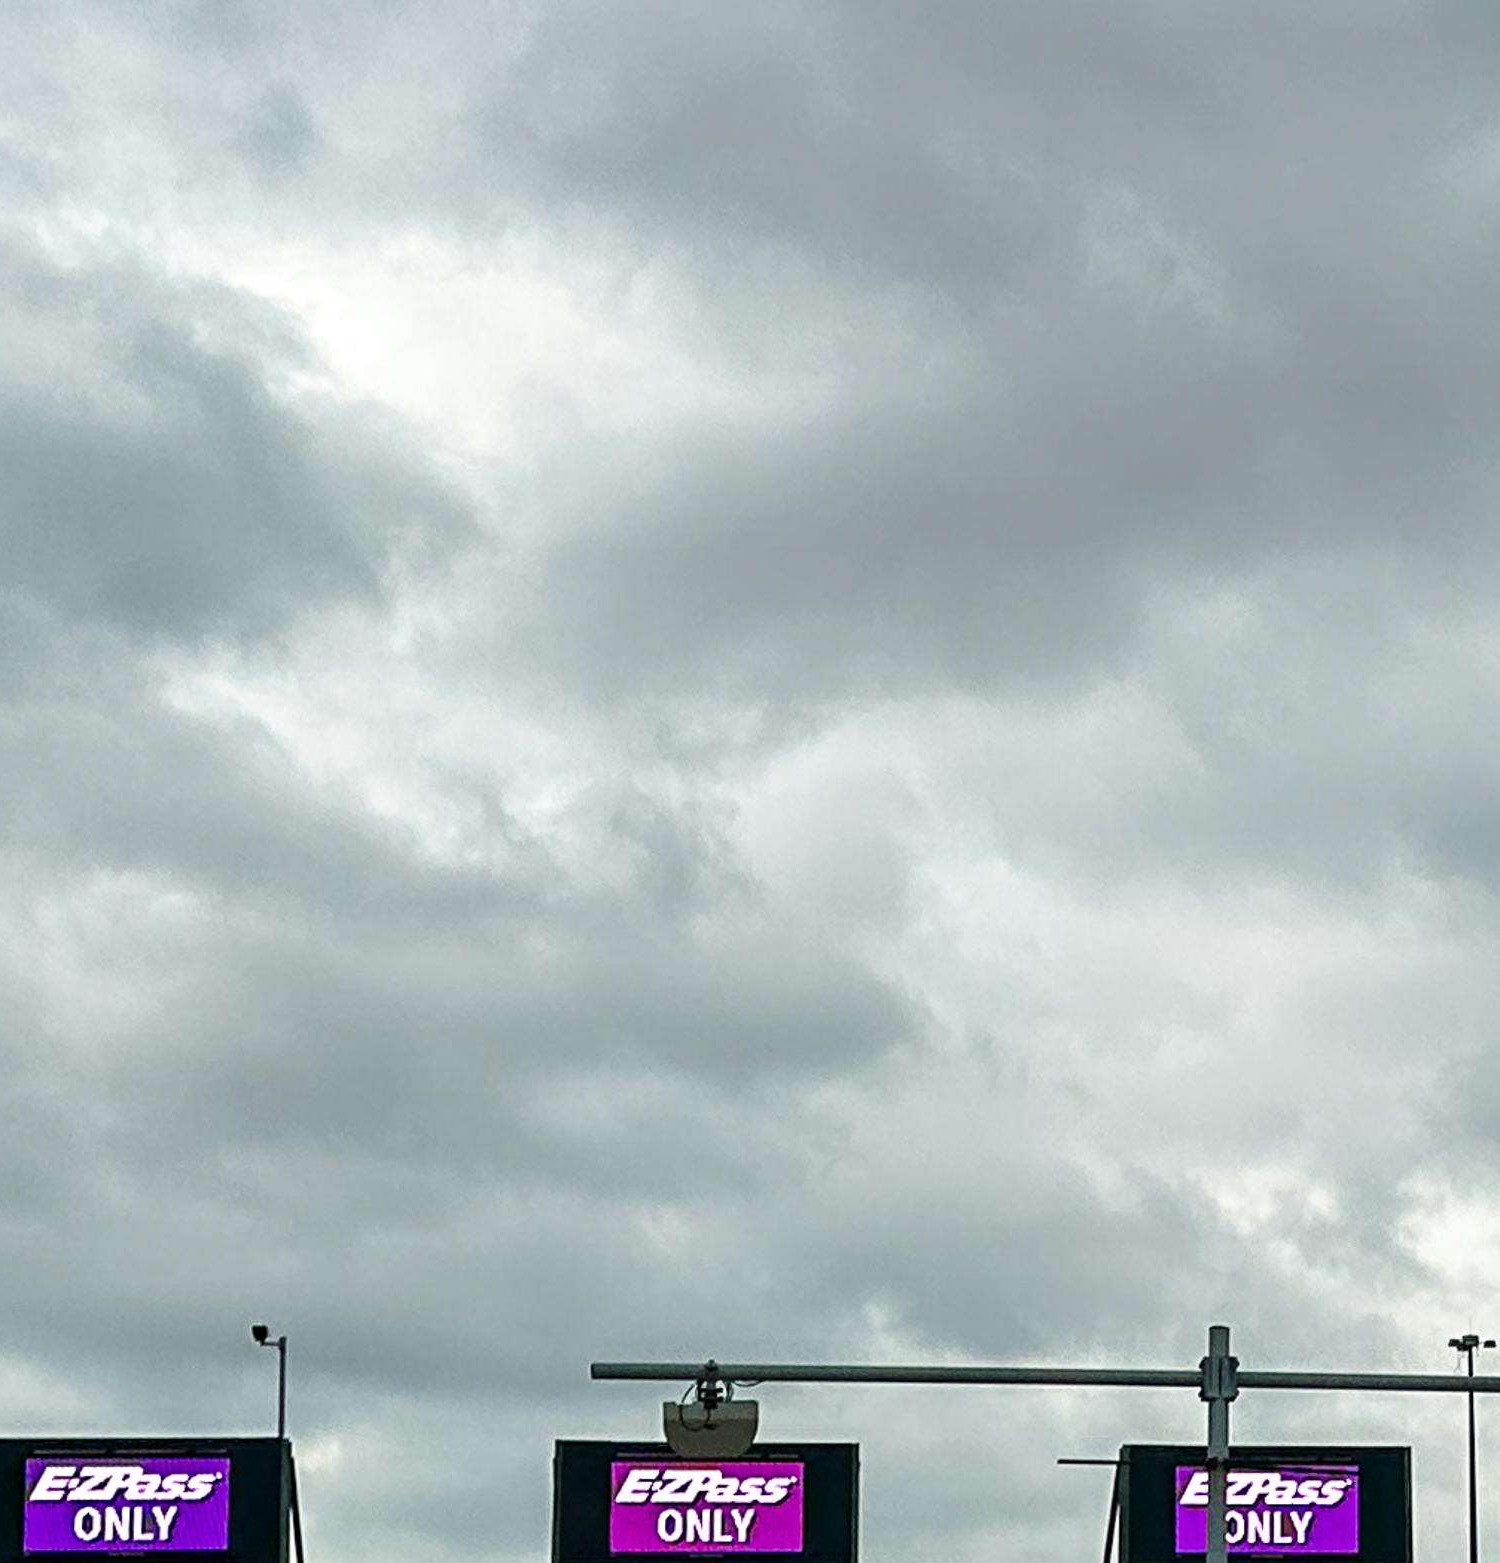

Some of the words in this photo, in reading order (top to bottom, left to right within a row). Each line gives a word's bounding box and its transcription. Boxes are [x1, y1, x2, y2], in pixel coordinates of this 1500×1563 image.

[1179, 1471, 1353, 1505] EZPass
[73, 1505, 178, 1541] ONLY
[657, 1508, 756, 1542] ONLY
[1225, 1510, 1313, 1544] ONLY
